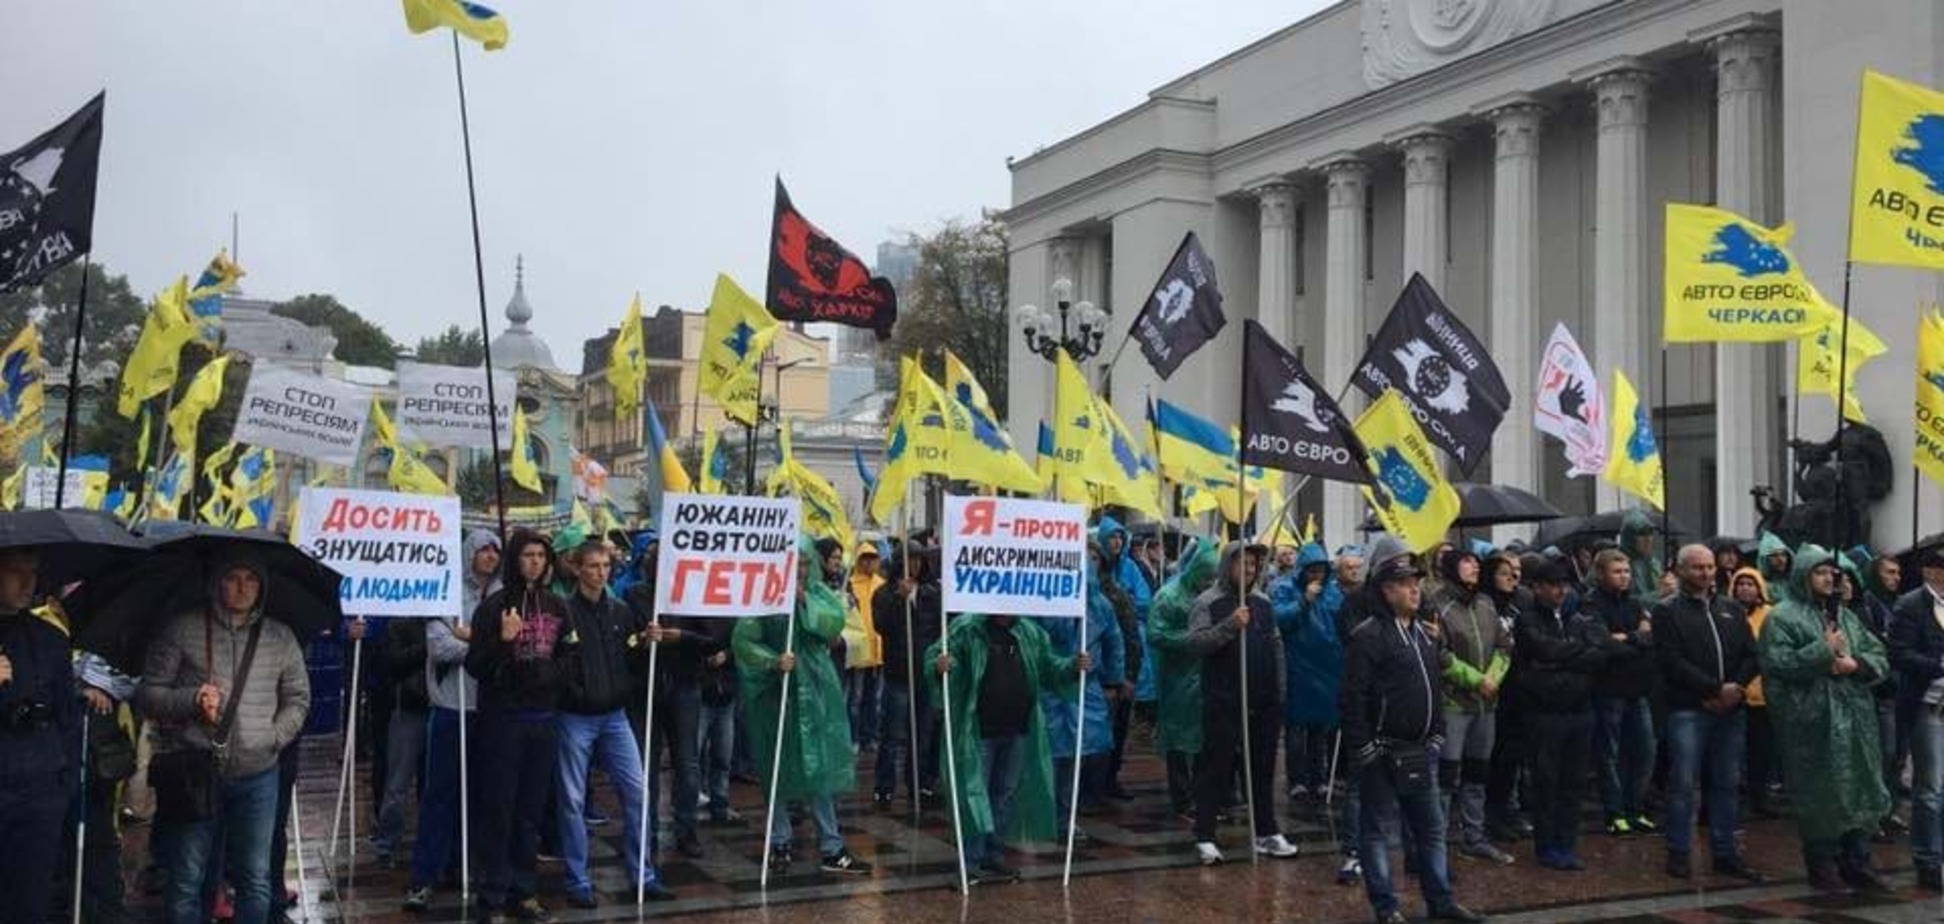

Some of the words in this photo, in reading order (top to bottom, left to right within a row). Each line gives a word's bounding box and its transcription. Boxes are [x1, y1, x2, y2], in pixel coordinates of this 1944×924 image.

[1682, 285, 1735, 300] АВТО
[285, 387, 336, 411] СТОП
[434, 382, 483, 400] СТОП
[250, 396, 358, 434] РЕПРЕСІЯМ
[1247, 433, 1290, 455] АВТО
[1294, 440, 1350, 465] ЄВРО
[960, 500, 996, 536] Я
[312, 538, 448, 567] ЗНУЩАТИСЬ
[356, 569, 451, 602] ЛЮДЬМИ!
[670, 549, 795, 607] ГЕТЬ!
